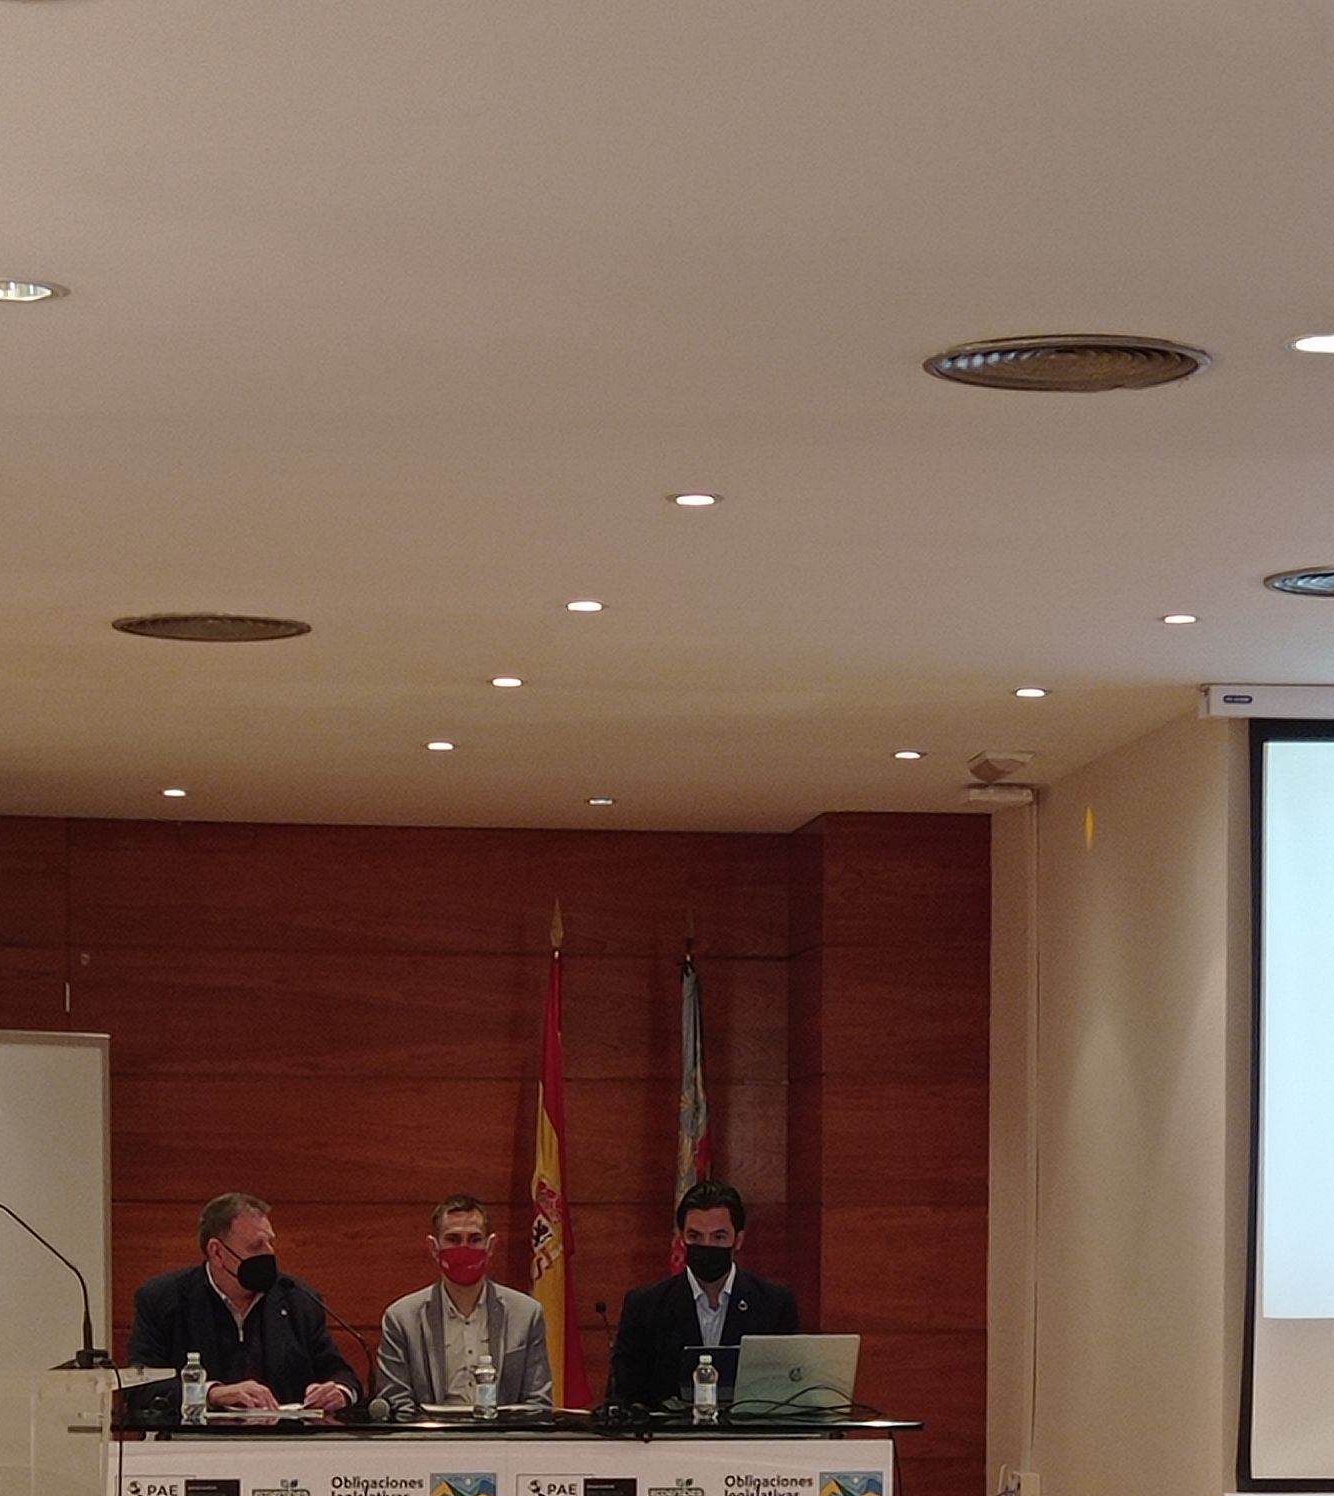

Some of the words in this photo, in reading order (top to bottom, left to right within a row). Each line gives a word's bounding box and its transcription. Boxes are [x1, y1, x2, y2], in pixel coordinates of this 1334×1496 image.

[331, 1476, 424, 1491] Obligaciones
[547, 1483, 578, 1496] PAE
[724, 1475, 813, 1490] Obligaciones
[147, 1484, 178, 1496] PAE
